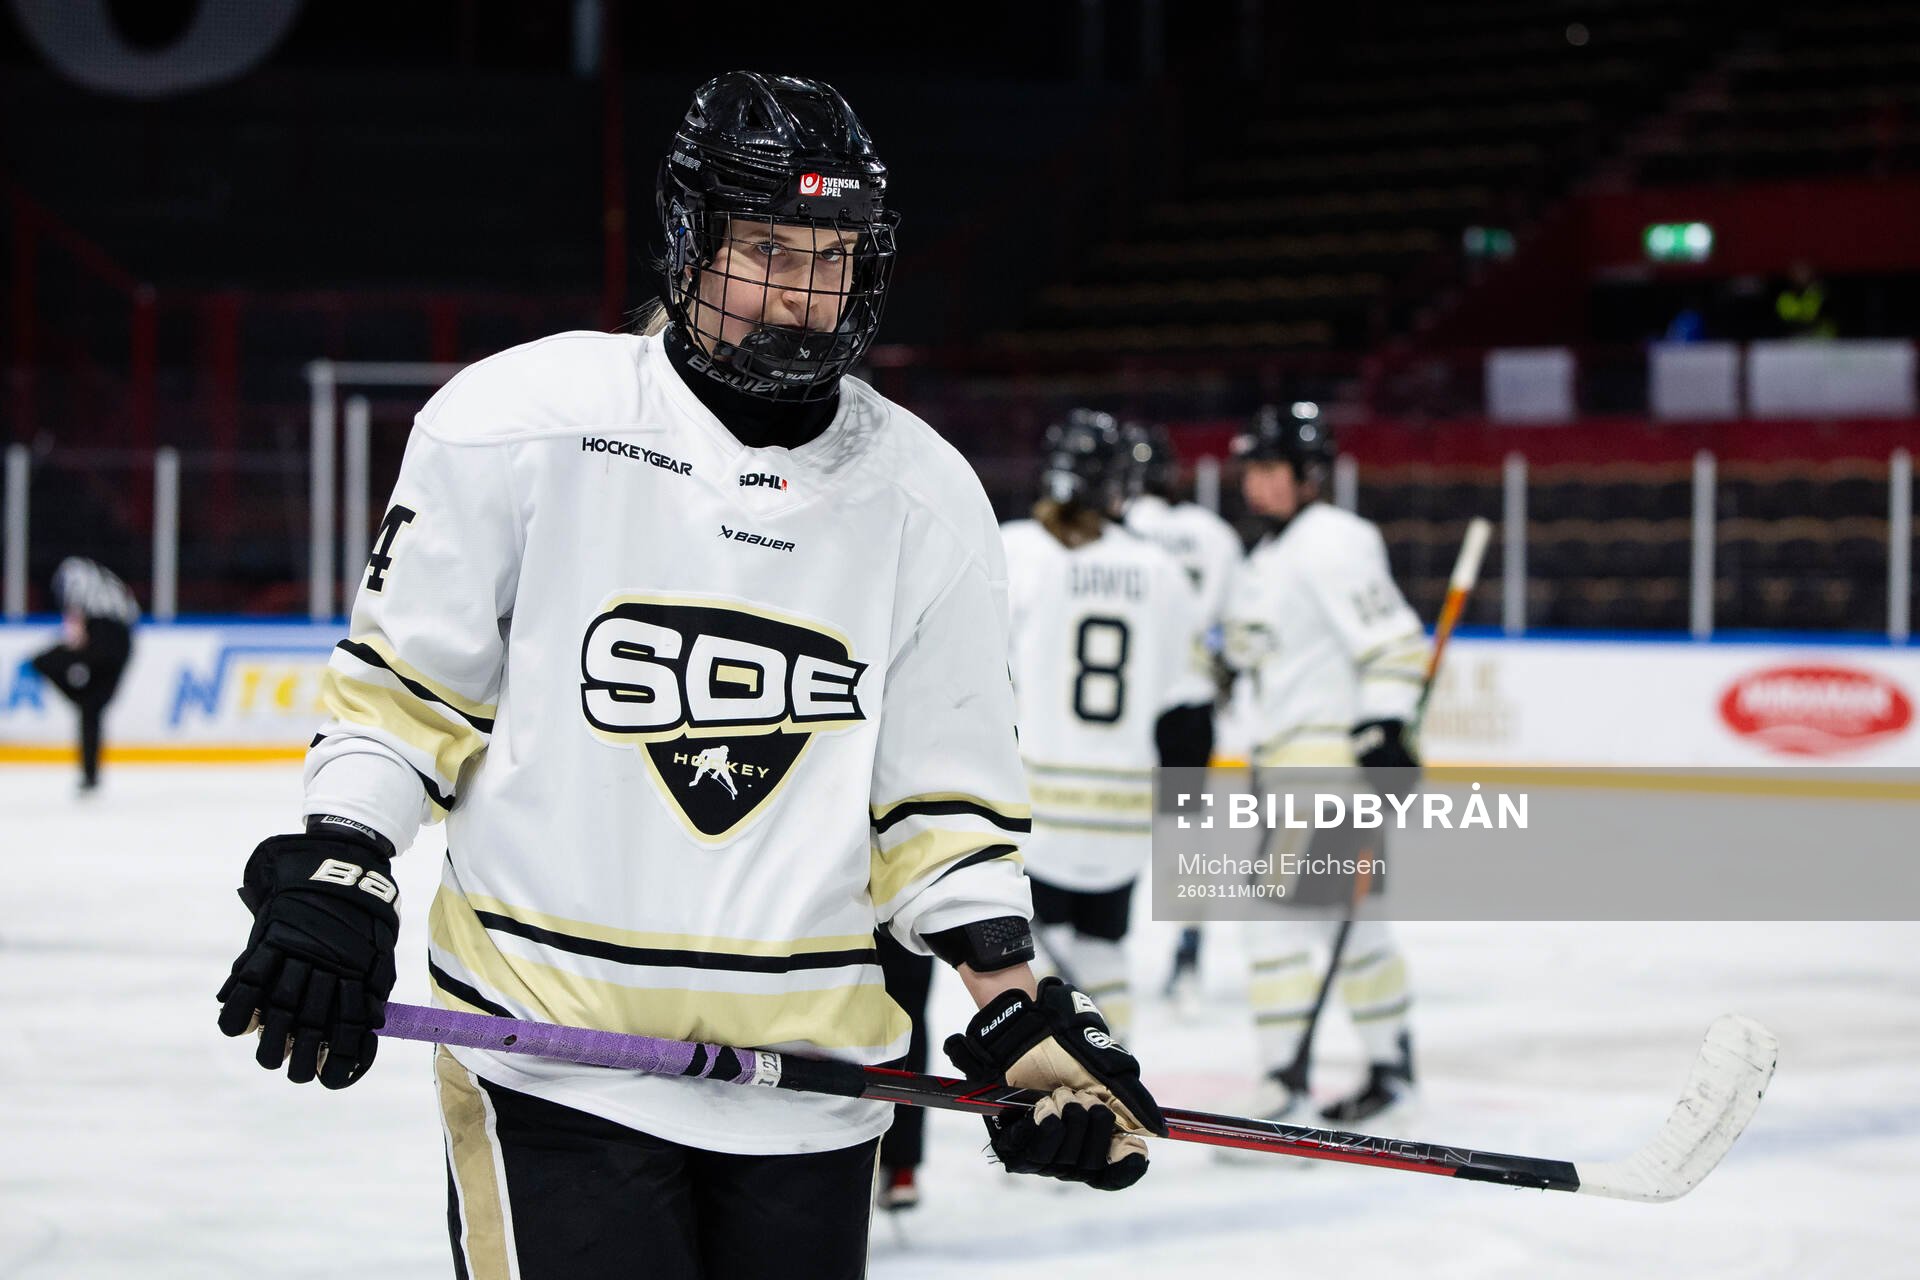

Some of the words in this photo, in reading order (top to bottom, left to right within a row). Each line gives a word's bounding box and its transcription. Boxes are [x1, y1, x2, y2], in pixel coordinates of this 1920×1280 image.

[821, 187, 842, 198] SPEL
[822, 177, 860, 190] SVENSKA
[582, 437, 693, 476] HOCKEYGEAR
[739, 473, 783, 491] SDHL
[734, 531, 796, 553] BAUER
[582, 612, 866, 730] SDE
[1073, 616, 1130, 723] 8
[673, 752, 770, 778] HOKEY
[980, 1001, 1023, 1037] BAUER
